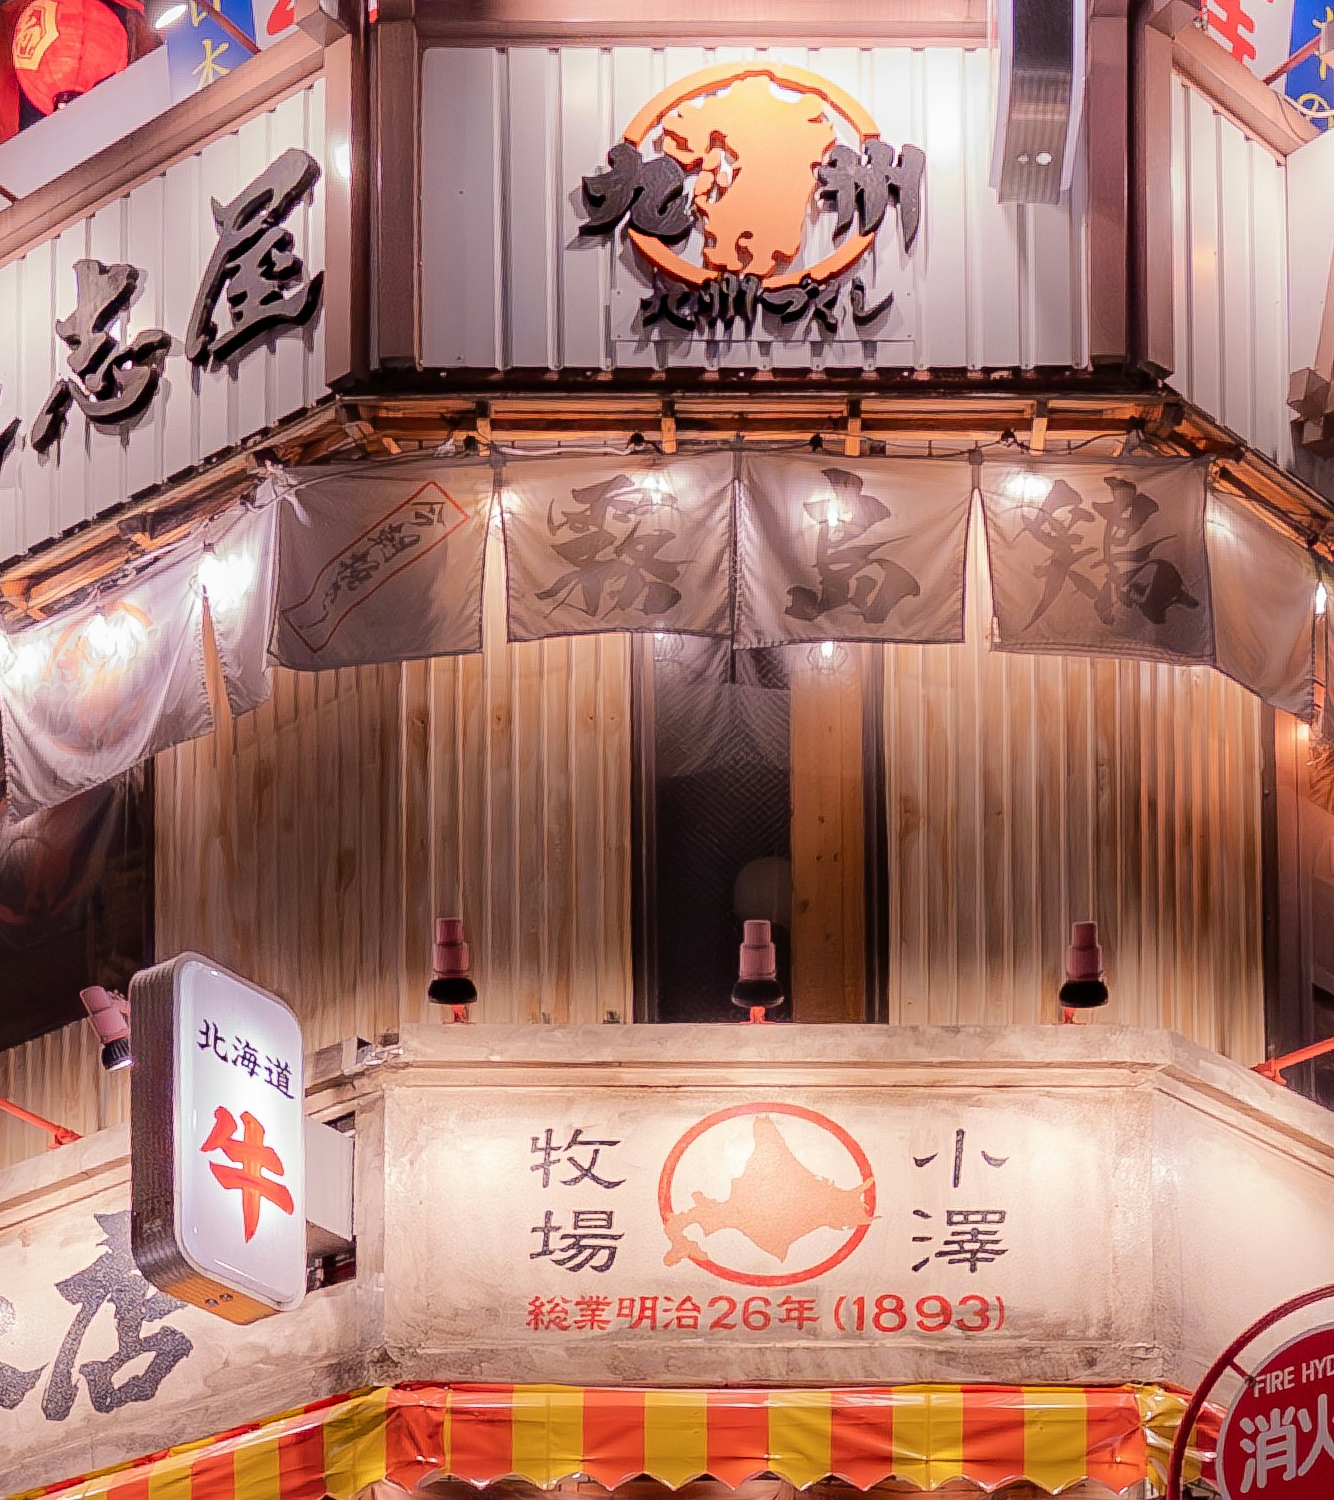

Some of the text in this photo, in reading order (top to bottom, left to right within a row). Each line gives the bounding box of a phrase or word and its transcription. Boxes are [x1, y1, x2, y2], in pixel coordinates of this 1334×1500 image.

[197, 1019, 295, 1100] 北海道
[201, 1106, 294, 1244] 牛
[529, 1126, 627, 1276] 牧場
[910, 1126, 1010, 1276] 小澤
[1253, 1365, 1296, 1397] FIRE
